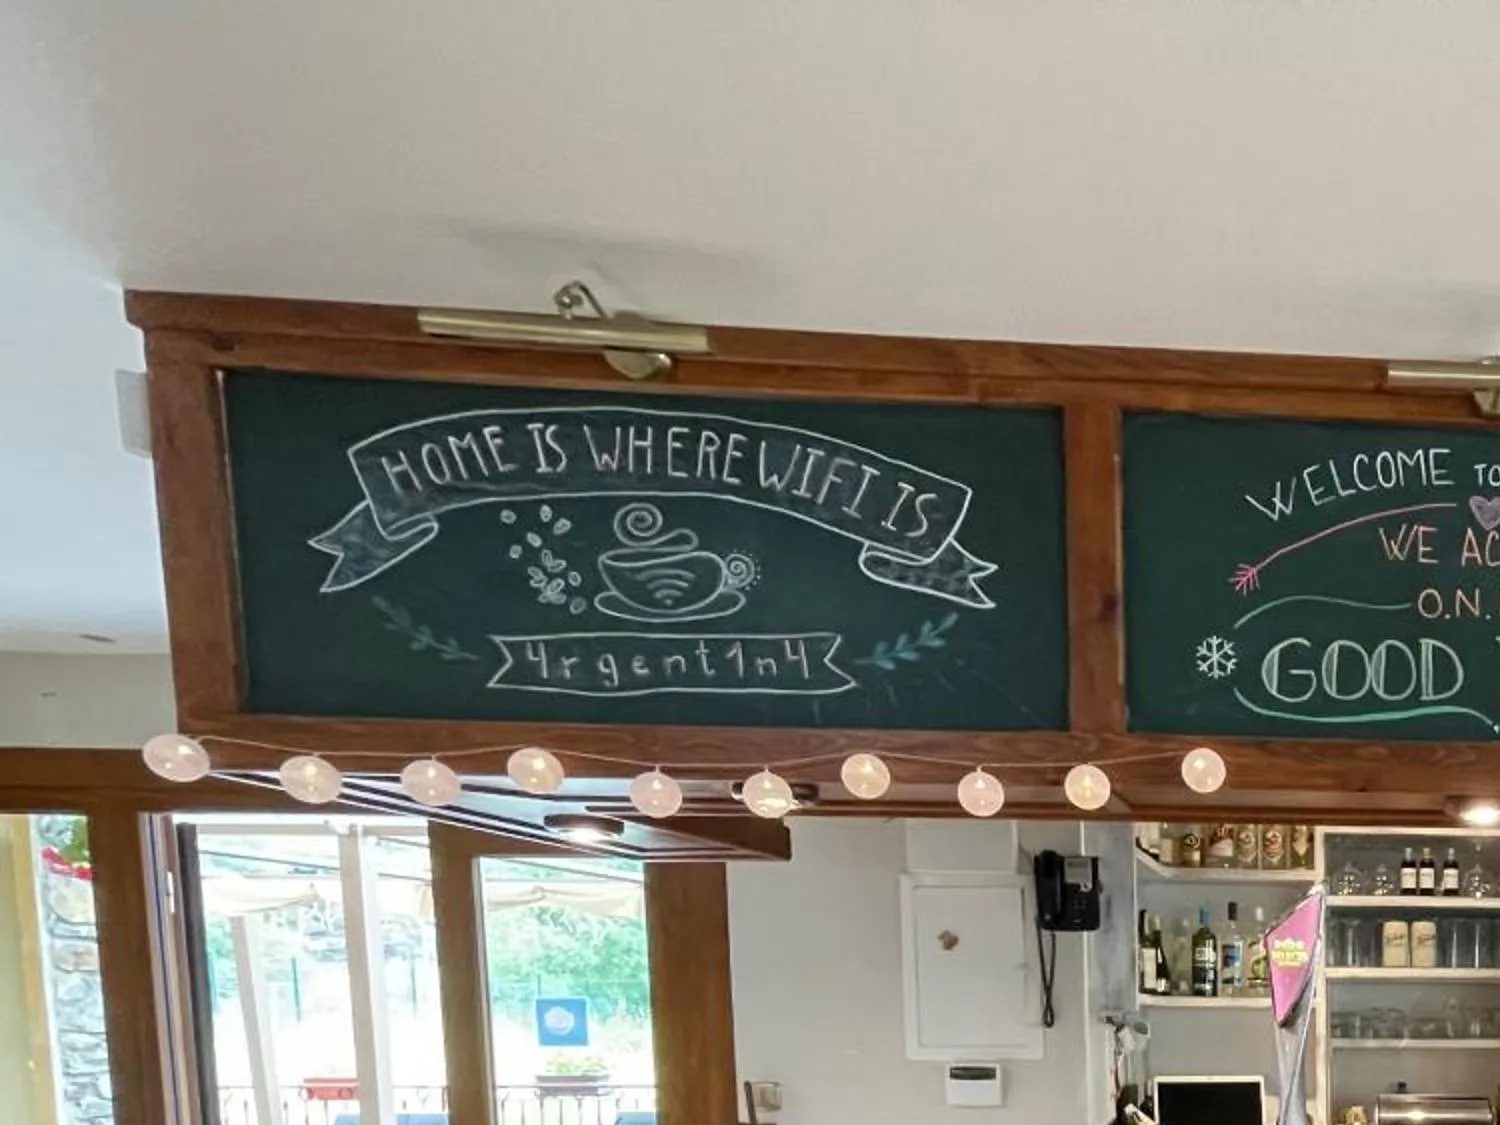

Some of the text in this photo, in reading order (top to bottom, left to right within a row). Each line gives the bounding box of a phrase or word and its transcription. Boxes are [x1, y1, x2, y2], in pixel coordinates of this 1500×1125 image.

[381, 422, 939, 538] HOME IS WHERE WIFI IS
[1245, 448, 1456, 522] WELCOME
[1379, 523, 1440, 565] WE
[1260, 637, 1465, 703] GOOD
